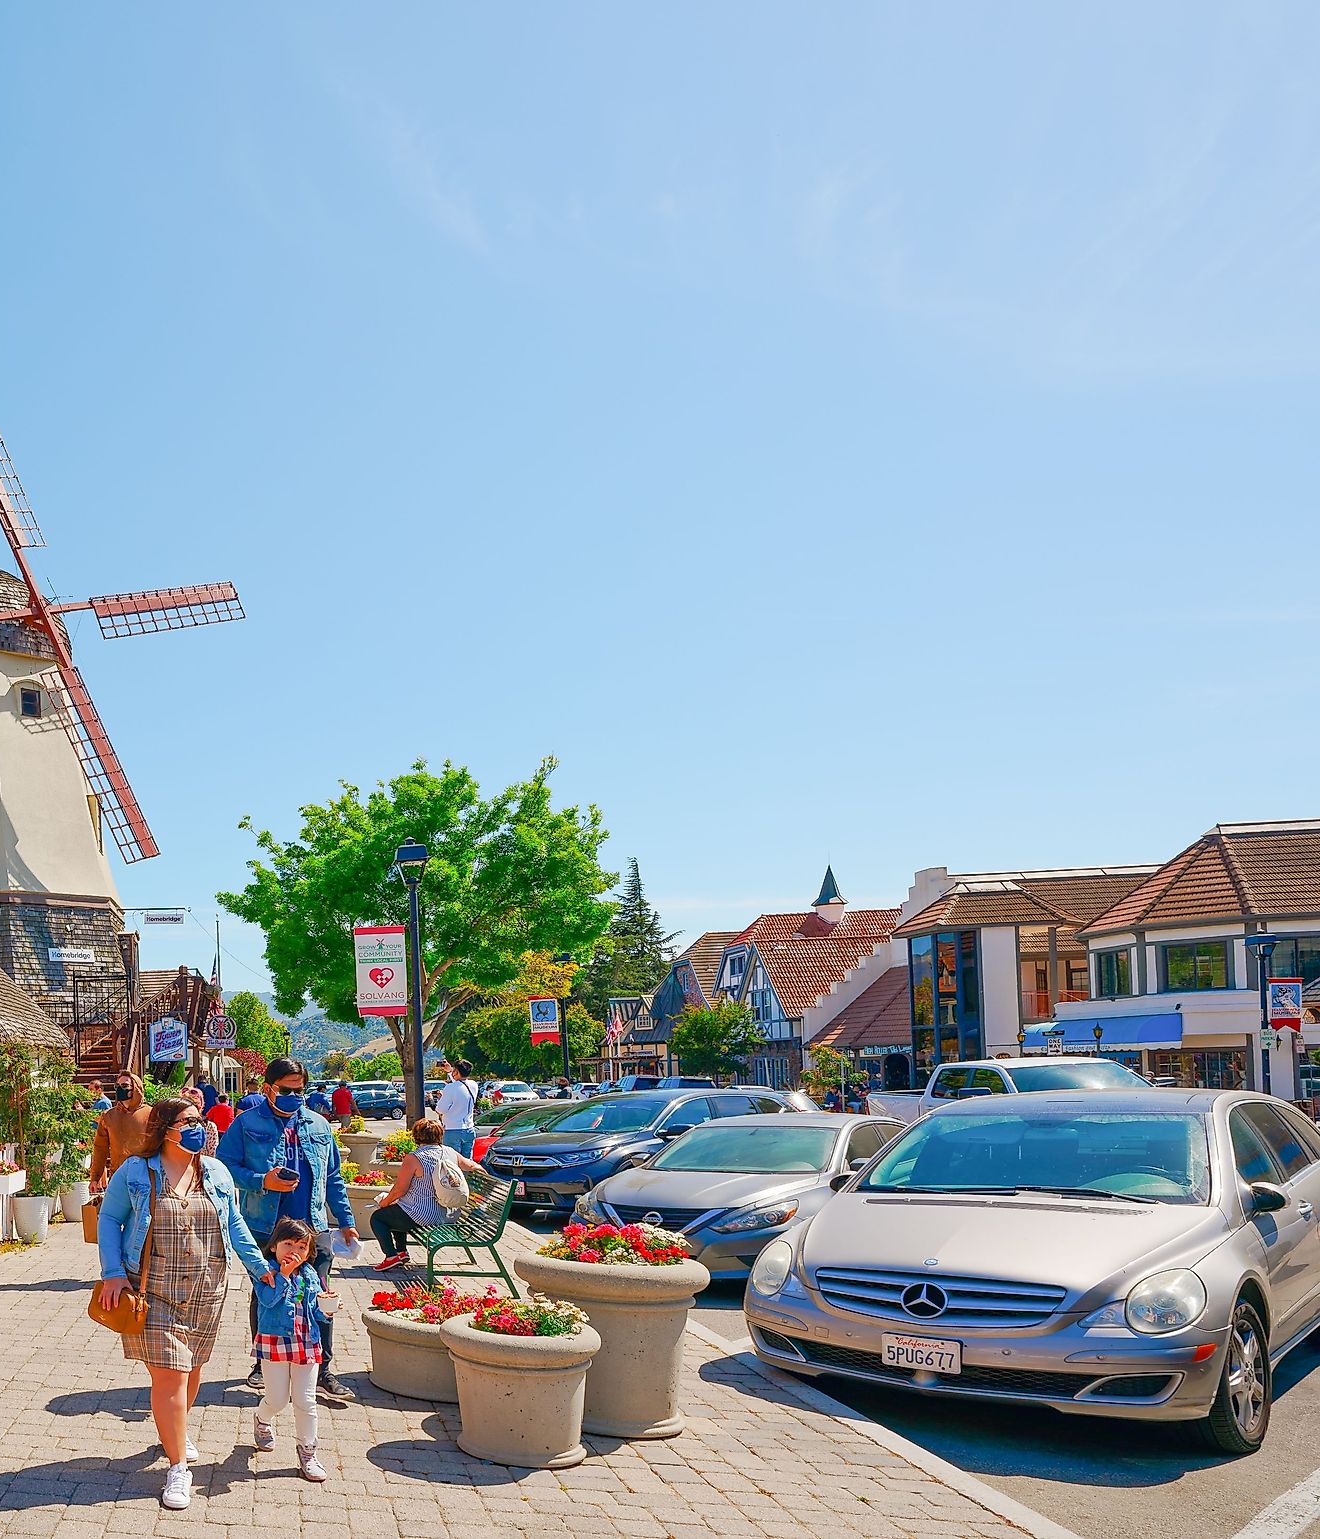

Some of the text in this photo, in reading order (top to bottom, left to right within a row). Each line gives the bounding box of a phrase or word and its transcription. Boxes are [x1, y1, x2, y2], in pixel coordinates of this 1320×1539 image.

[52, 951, 91, 960] Homebridge
[360, 992, 405, 1000] SOLVANG
[155, 1030, 181, 1041] Tower
[155, 1039, 184, 1052] Pizza
[897, 1338, 941, 1349] California
[887, 1345, 955, 1369] 5PUG677
